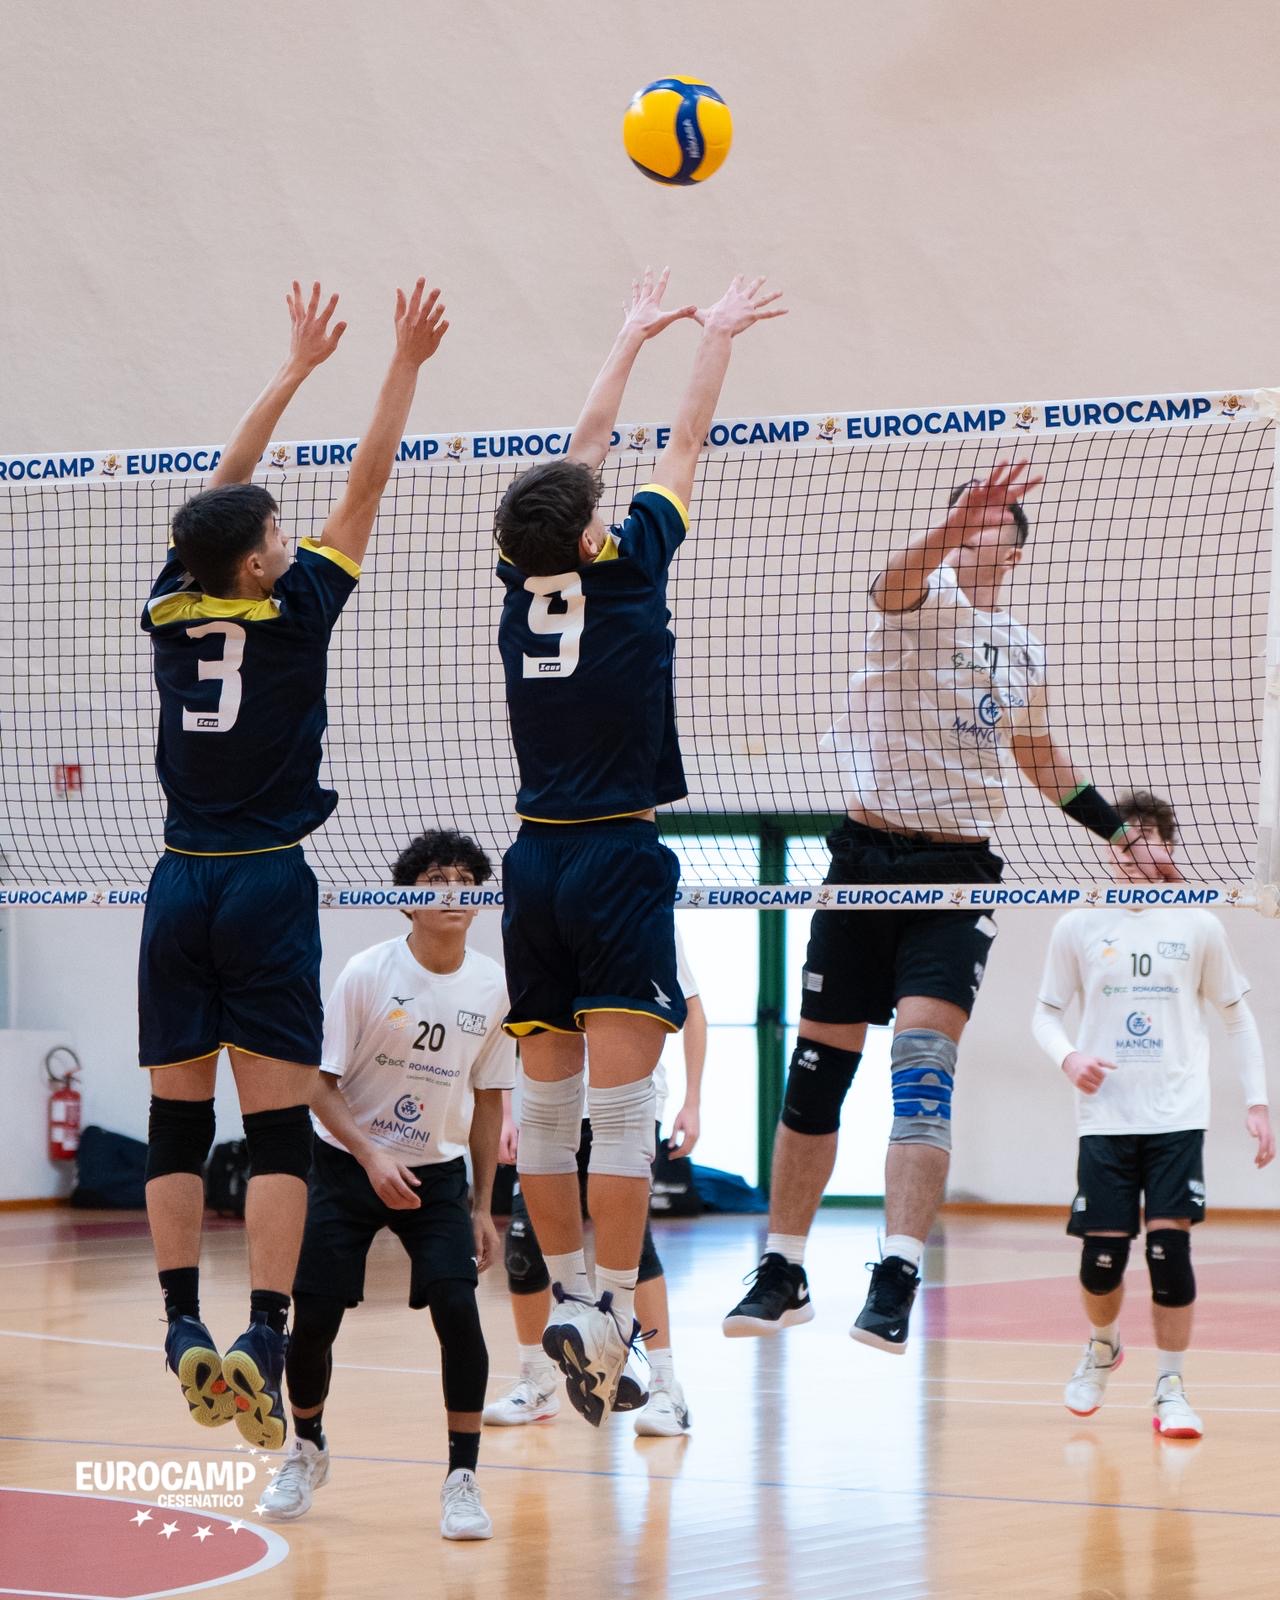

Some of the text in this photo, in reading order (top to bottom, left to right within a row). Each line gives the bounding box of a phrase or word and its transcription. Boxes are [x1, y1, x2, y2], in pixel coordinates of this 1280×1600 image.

[656, 420, 810, 449] EOCAMP
[847, 409, 1006, 439] EUROCAMP
[1045, 398, 1211, 427] EUROCAMP
[522, 571, 586, 679] 9
[182, 620, 246, 733] 3
[0, 890, 88, 905] EUROCAMP
[339, 891, 436, 906] EUROCAMP
[708, 890, 812, 905] EUROCAMP
[836, 890, 944, 905] EUROCAMP
[970, 889, 1080, 904] EUROCAMP
[1105, 889, 1219, 905] EUROCAMP
[1131, 953, 1152, 977] 10
[412, 1020, 446, 1053] 20
[388, 1058, 406, 1068] BCC
[371, 1117, 431, 1143] MANCINI
